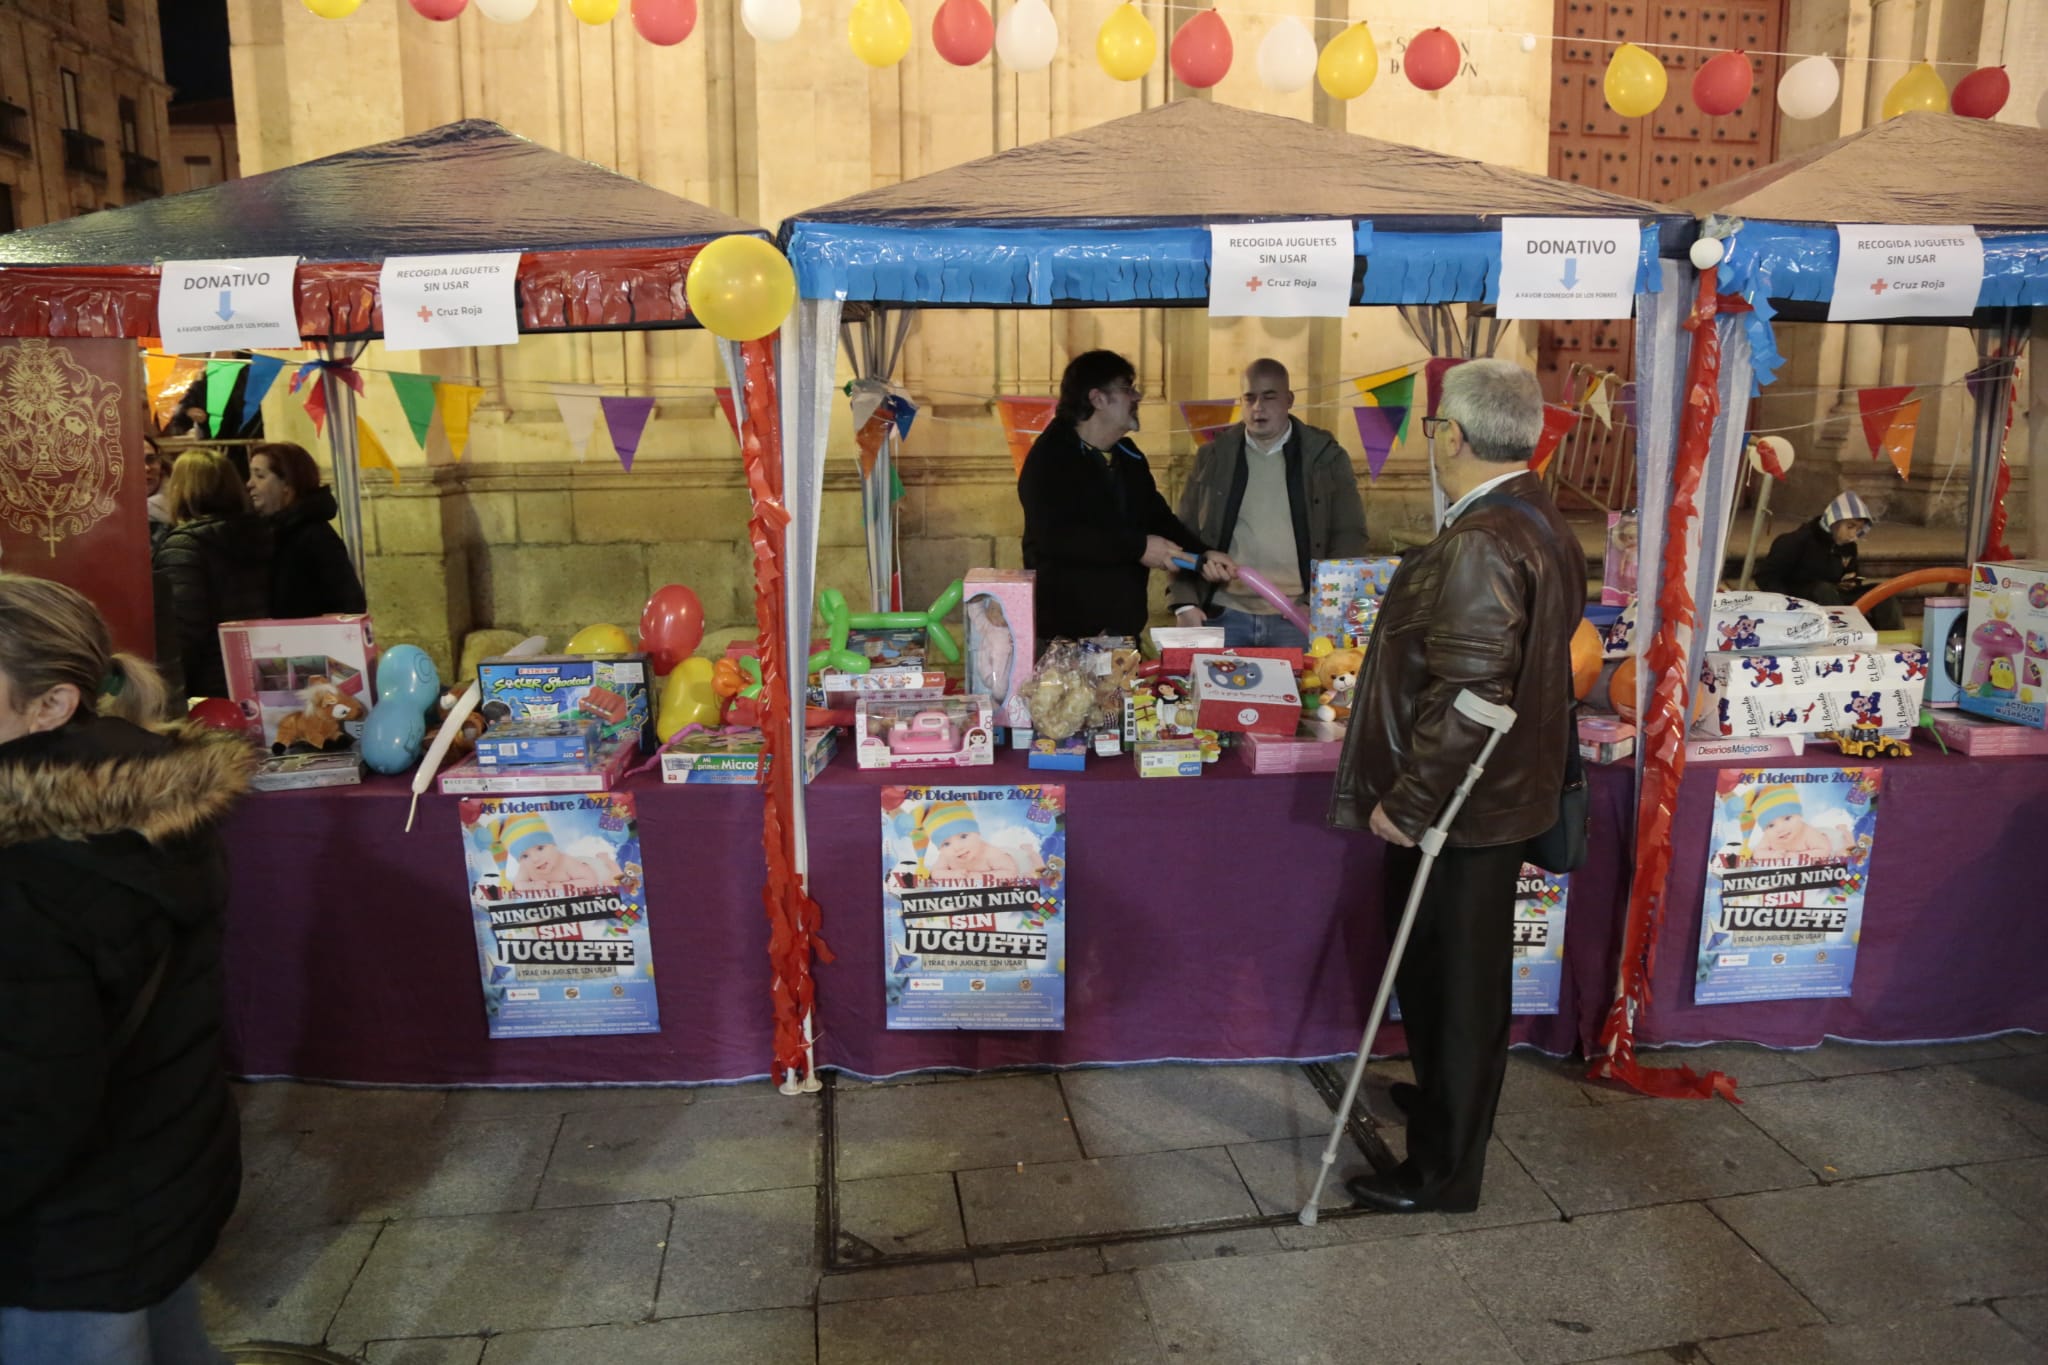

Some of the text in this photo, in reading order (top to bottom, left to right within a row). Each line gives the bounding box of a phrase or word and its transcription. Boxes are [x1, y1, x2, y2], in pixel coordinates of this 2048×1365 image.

[1229, 237, 1337, 248] RECOGIDA JUGUETES
[1527, 240, 1616, 255] DONATIVO
[1858, 239, 1965, 250] RECOGIDA JUGUETES
[1259, 254, 1307, 264] SIN USAR
[1887, 254, 1936, 265] SIN USAR
[397, 265, 500, 279] RECOGIDA JUGUETES
[184, 272, 271, 290] DONATIVO
[424, 281, 469, 292] SIN USAR
[1267, 279, 1317, 288] Cruz Roja
[1893, 280, 1945, 290] Cruz Roja
[437, 306, 483, 317] Cruz Roja
[1741, 696, 1757, 725] Barato
[1816, 692, 1832, 721] Barato
[1892, 689, 1906, 717] Barato
[2005, 701, 2041, 713] ACTIVITY
[1994, 707, 2040, 722] MUSHROOM
[1738, 771, 1863, 784] 26 Diciembre 2022
[904, 788, 1042, 802] 26 Diciembre 2022
[480, 797, 613, 815] 26 Diciembre 2022
[1516, 877, 1544, 894] ÑO
[1722, 866, 1847, 892] NINGÚN NIÑO
[902, 889, 1040, 913] NINGÚN NIÑO
[1764, 890, 1802, 907] SIN
[491, 896, 622, 925] NINGÚN NIÑO
[950, 913, 993, 930] SIN
[1719, 908, 1848, 931] JUGUETE
[538, 922, 579, 940] SIN
[904, 929, 1047, 956] JUGUETE
[496, 940, 635, 964] JUGUETE
